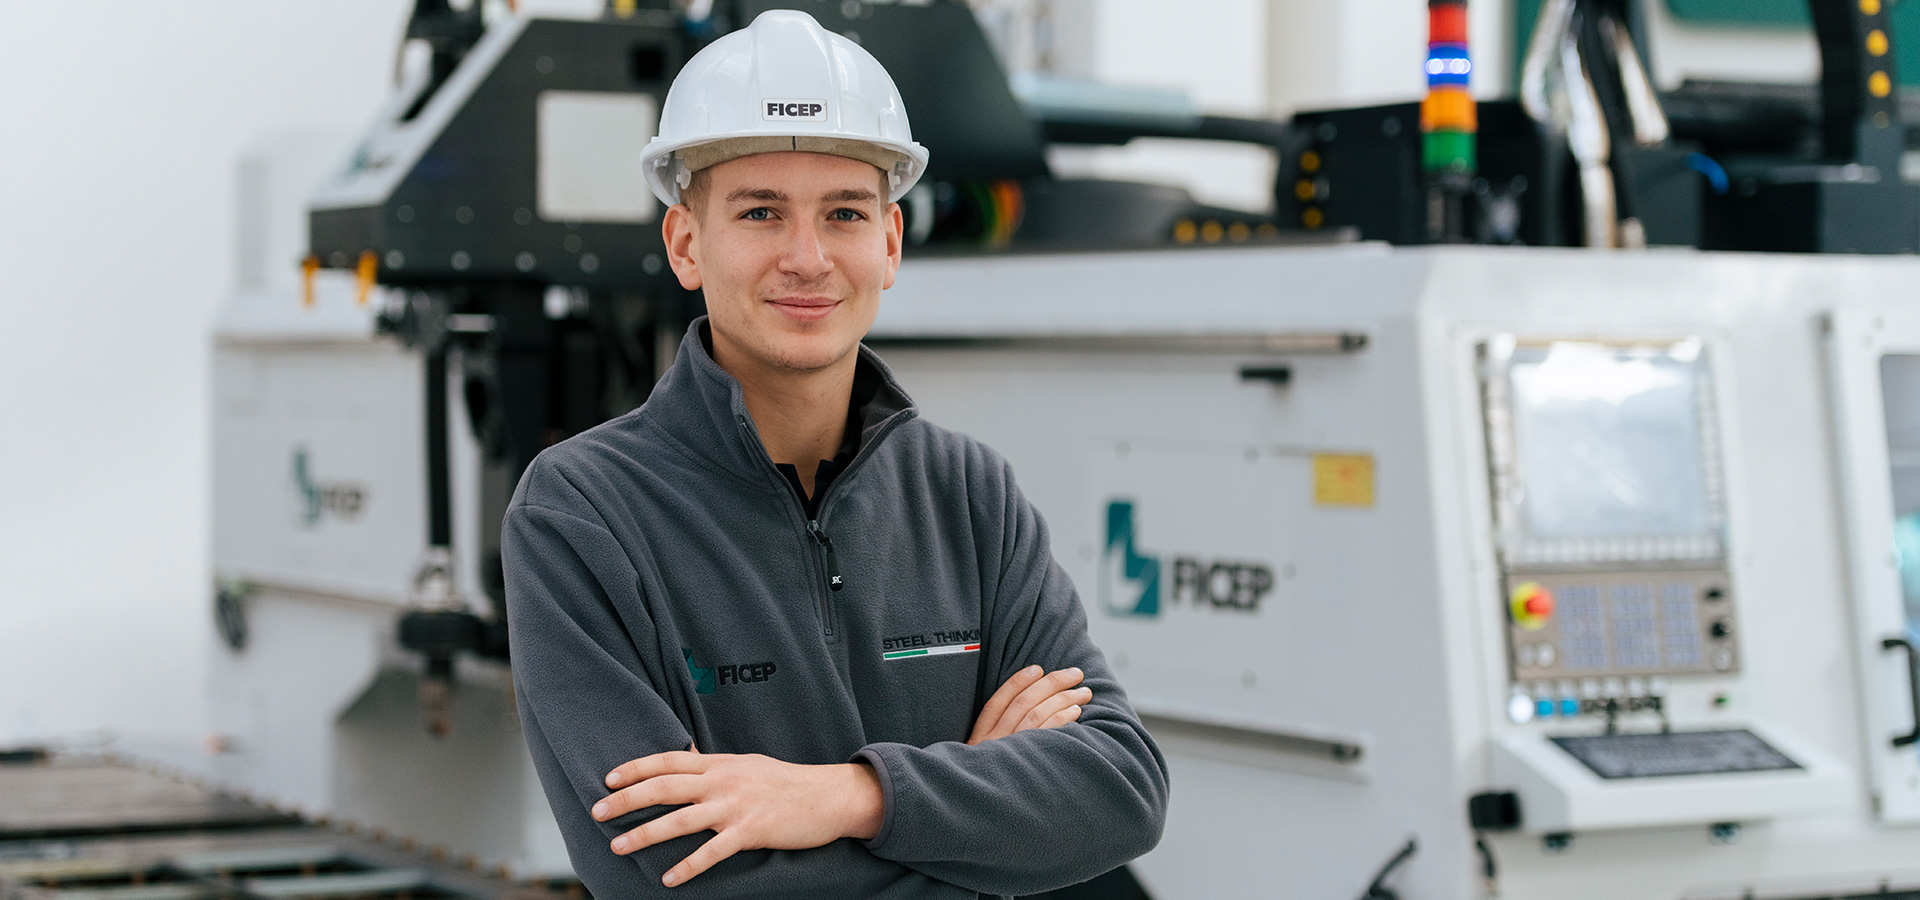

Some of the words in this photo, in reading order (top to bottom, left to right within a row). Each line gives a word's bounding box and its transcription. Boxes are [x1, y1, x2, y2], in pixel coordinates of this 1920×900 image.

[767, 103, 822, 116] FICEP
[1171, 556, 1275, 612] FICEP
[882, 634, 931, 650] STEEL
[718, 661, 776, 686] FICEP
